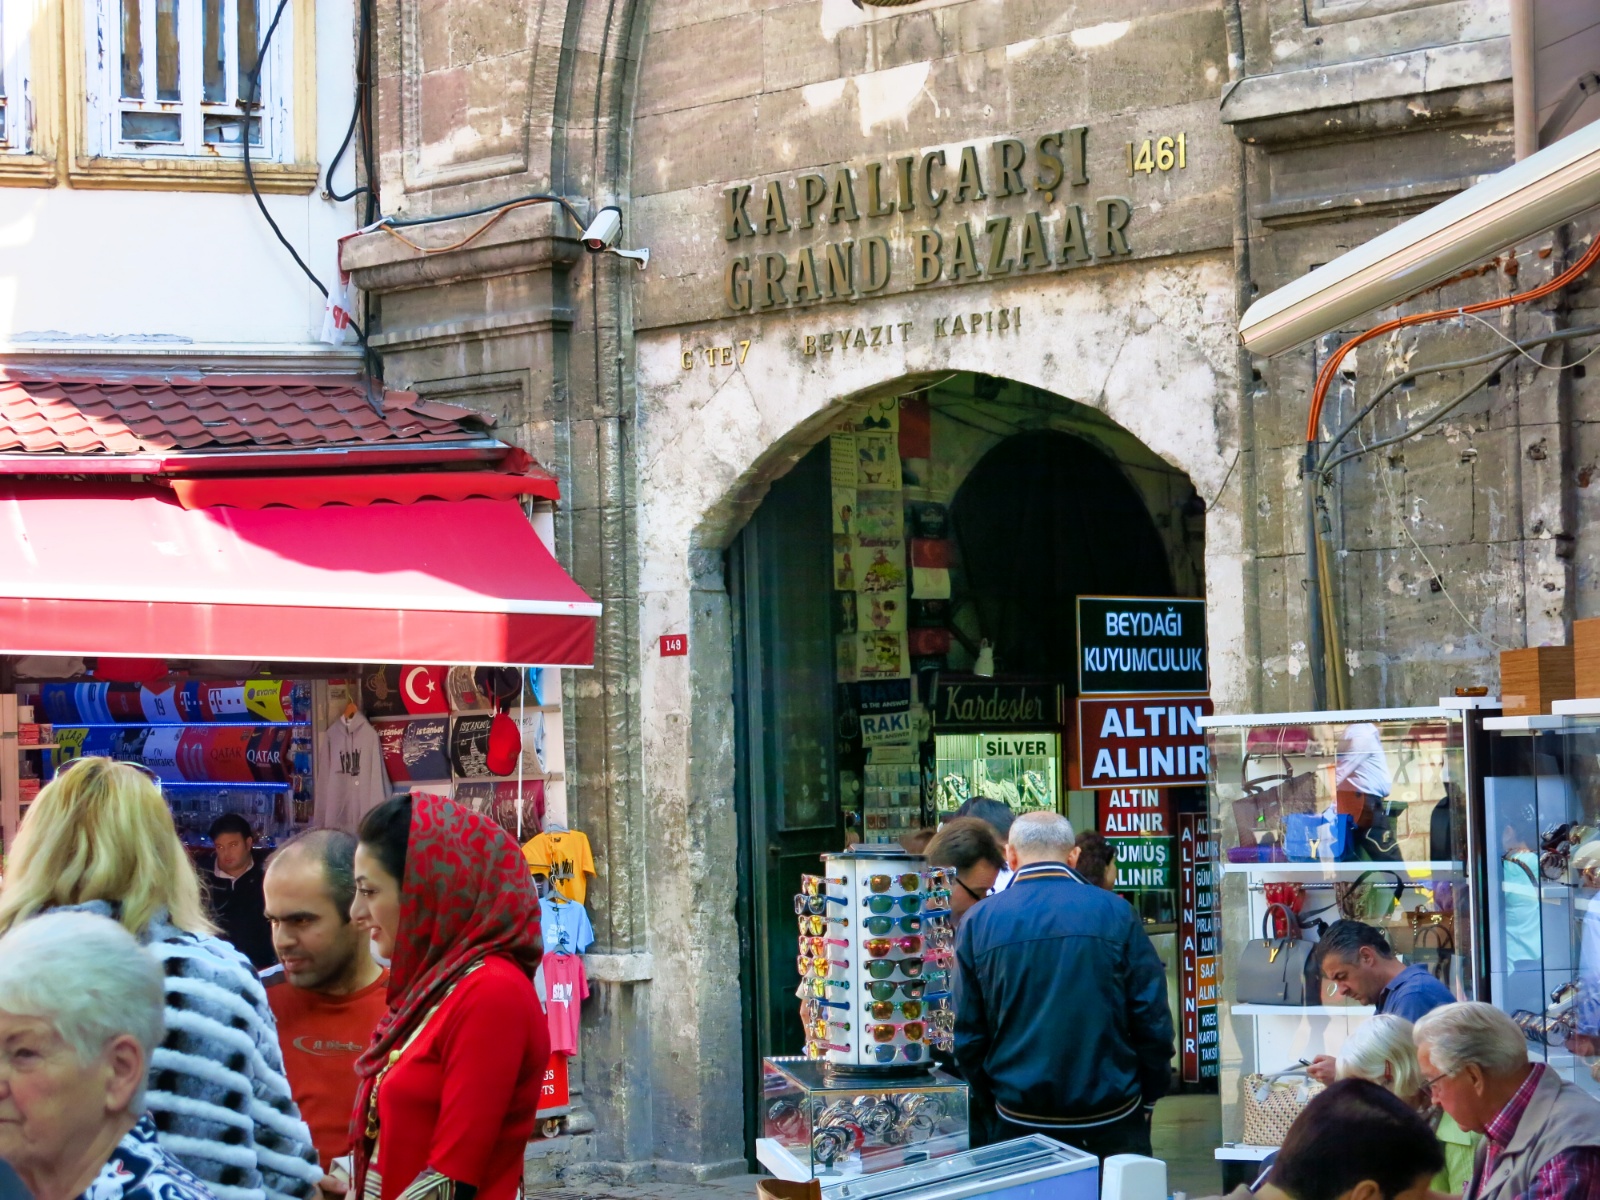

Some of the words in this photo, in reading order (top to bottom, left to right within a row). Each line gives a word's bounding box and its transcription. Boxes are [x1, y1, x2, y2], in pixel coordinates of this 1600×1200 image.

[1125, 131, 1186, 177] 1461
[722, 124, 1090, 241] KAPALIÇARŞI
[723, 233, 892, 312] GRAND
[912, 196, 1134, 288] BAZAAR
[803, 320, 913, 356] BEYAZIT
[932, 305, 1023, 339] KAPISI
[681, 345, 733, 371] GTE
[739, 340, 751, 365] 7
[1105, 606, 1183, 637] BEYDAĞI
[665, 638, 682, 652] 149
[1084, 647, 1203, 672] KUYUMCULUK
[153, 698, 166, 716] 19
[945, 685, 1045, 723] Kardeşler
[863, 713, 910, 735] RAKI
[1100, 706, 1204, 738] ALTIN
[246, 749, 281, 764] QATAR
[986, 737, 1047, 757] SİLVER
[1092, 745, 1212, 779] ALINIR
[1109, 788, 1159, 808] ALTIN
[1105, 813, 1164, 832] ALINIR
[1116, 841, 1166, 867] ÜMÜŞ
